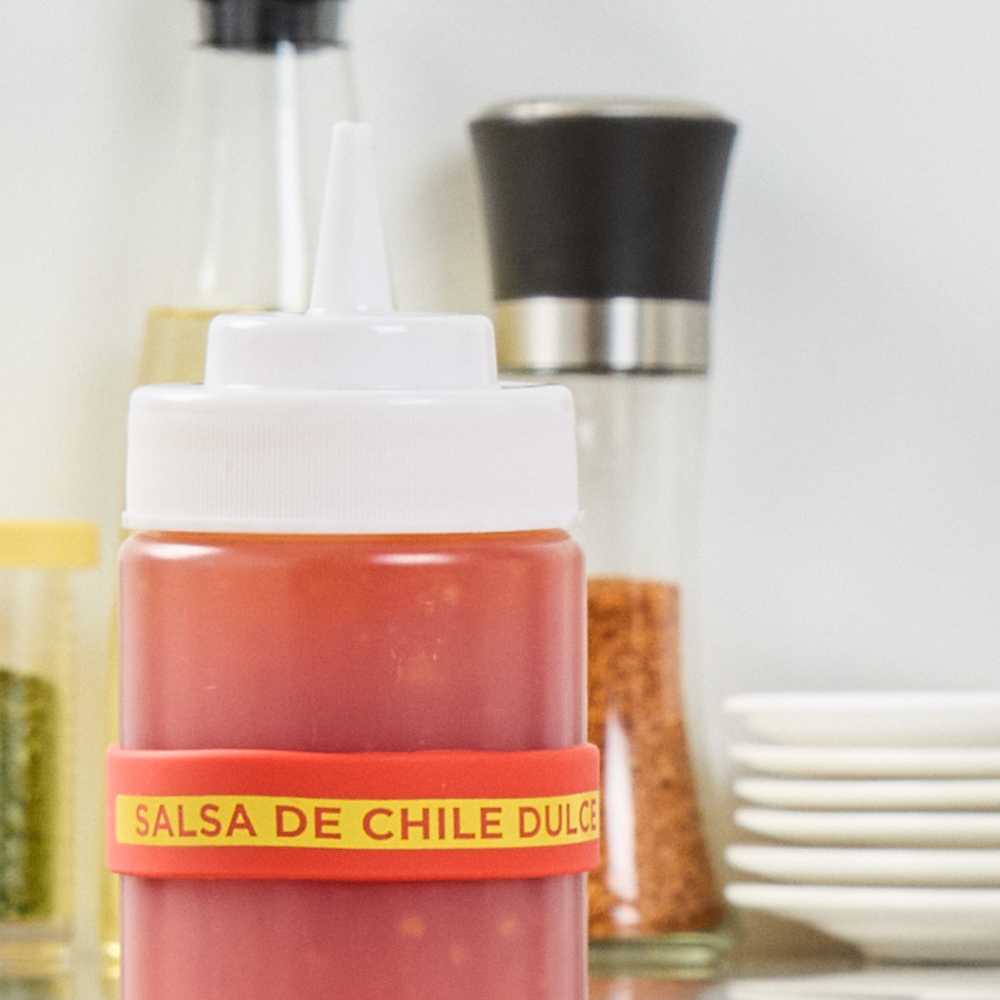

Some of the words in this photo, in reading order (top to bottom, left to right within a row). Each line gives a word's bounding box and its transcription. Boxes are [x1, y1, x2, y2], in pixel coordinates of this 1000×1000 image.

[135, 803, 257, 838] SALSA
[275, 806, 342, 840] DE
[362, 807, 503, 840] CHILE
[518, 799, 598, 839] DULCE
